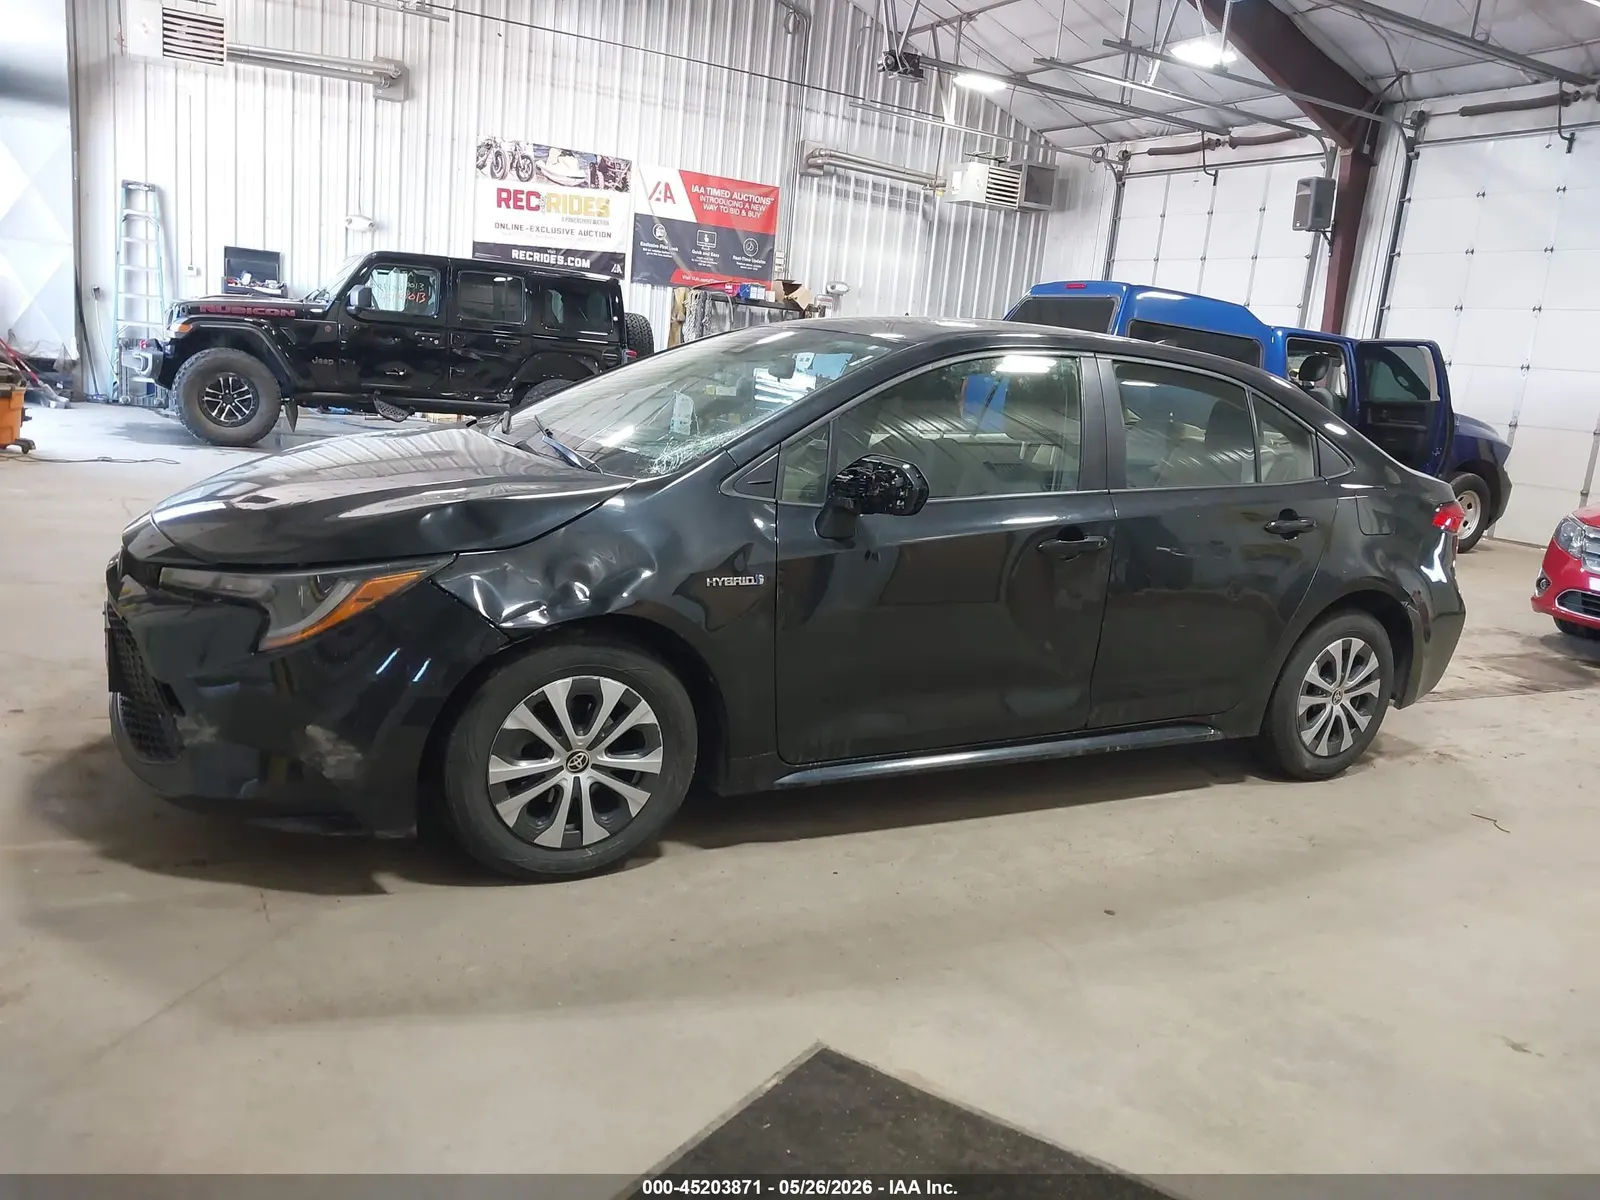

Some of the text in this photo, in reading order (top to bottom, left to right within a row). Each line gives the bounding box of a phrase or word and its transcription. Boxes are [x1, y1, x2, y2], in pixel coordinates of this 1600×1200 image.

[691, 184, 705, 194] IAA
[706, 186, 731, 198] TIMED
[496, 187, 610, 218] REC RIDES
[700, 195, 743, 208] INTRODUCING
[750, 203, 766, 212] NEW
[703, 203, 719, 212] WAY
[719, 205, 729, 213] TO
[729, 207, 740, 216] BID
[747, 210, 761, 219] BUY
[494, 221, 575, 236] ONLINE-EXCLUSIVE
[578, 229, 612, 239] AUCTION
[511, 249, 591, 269] RECRIDES.COM
[199, 304, 296, 317] RUBICON
[706, 576, 756, 587] HYBRID
